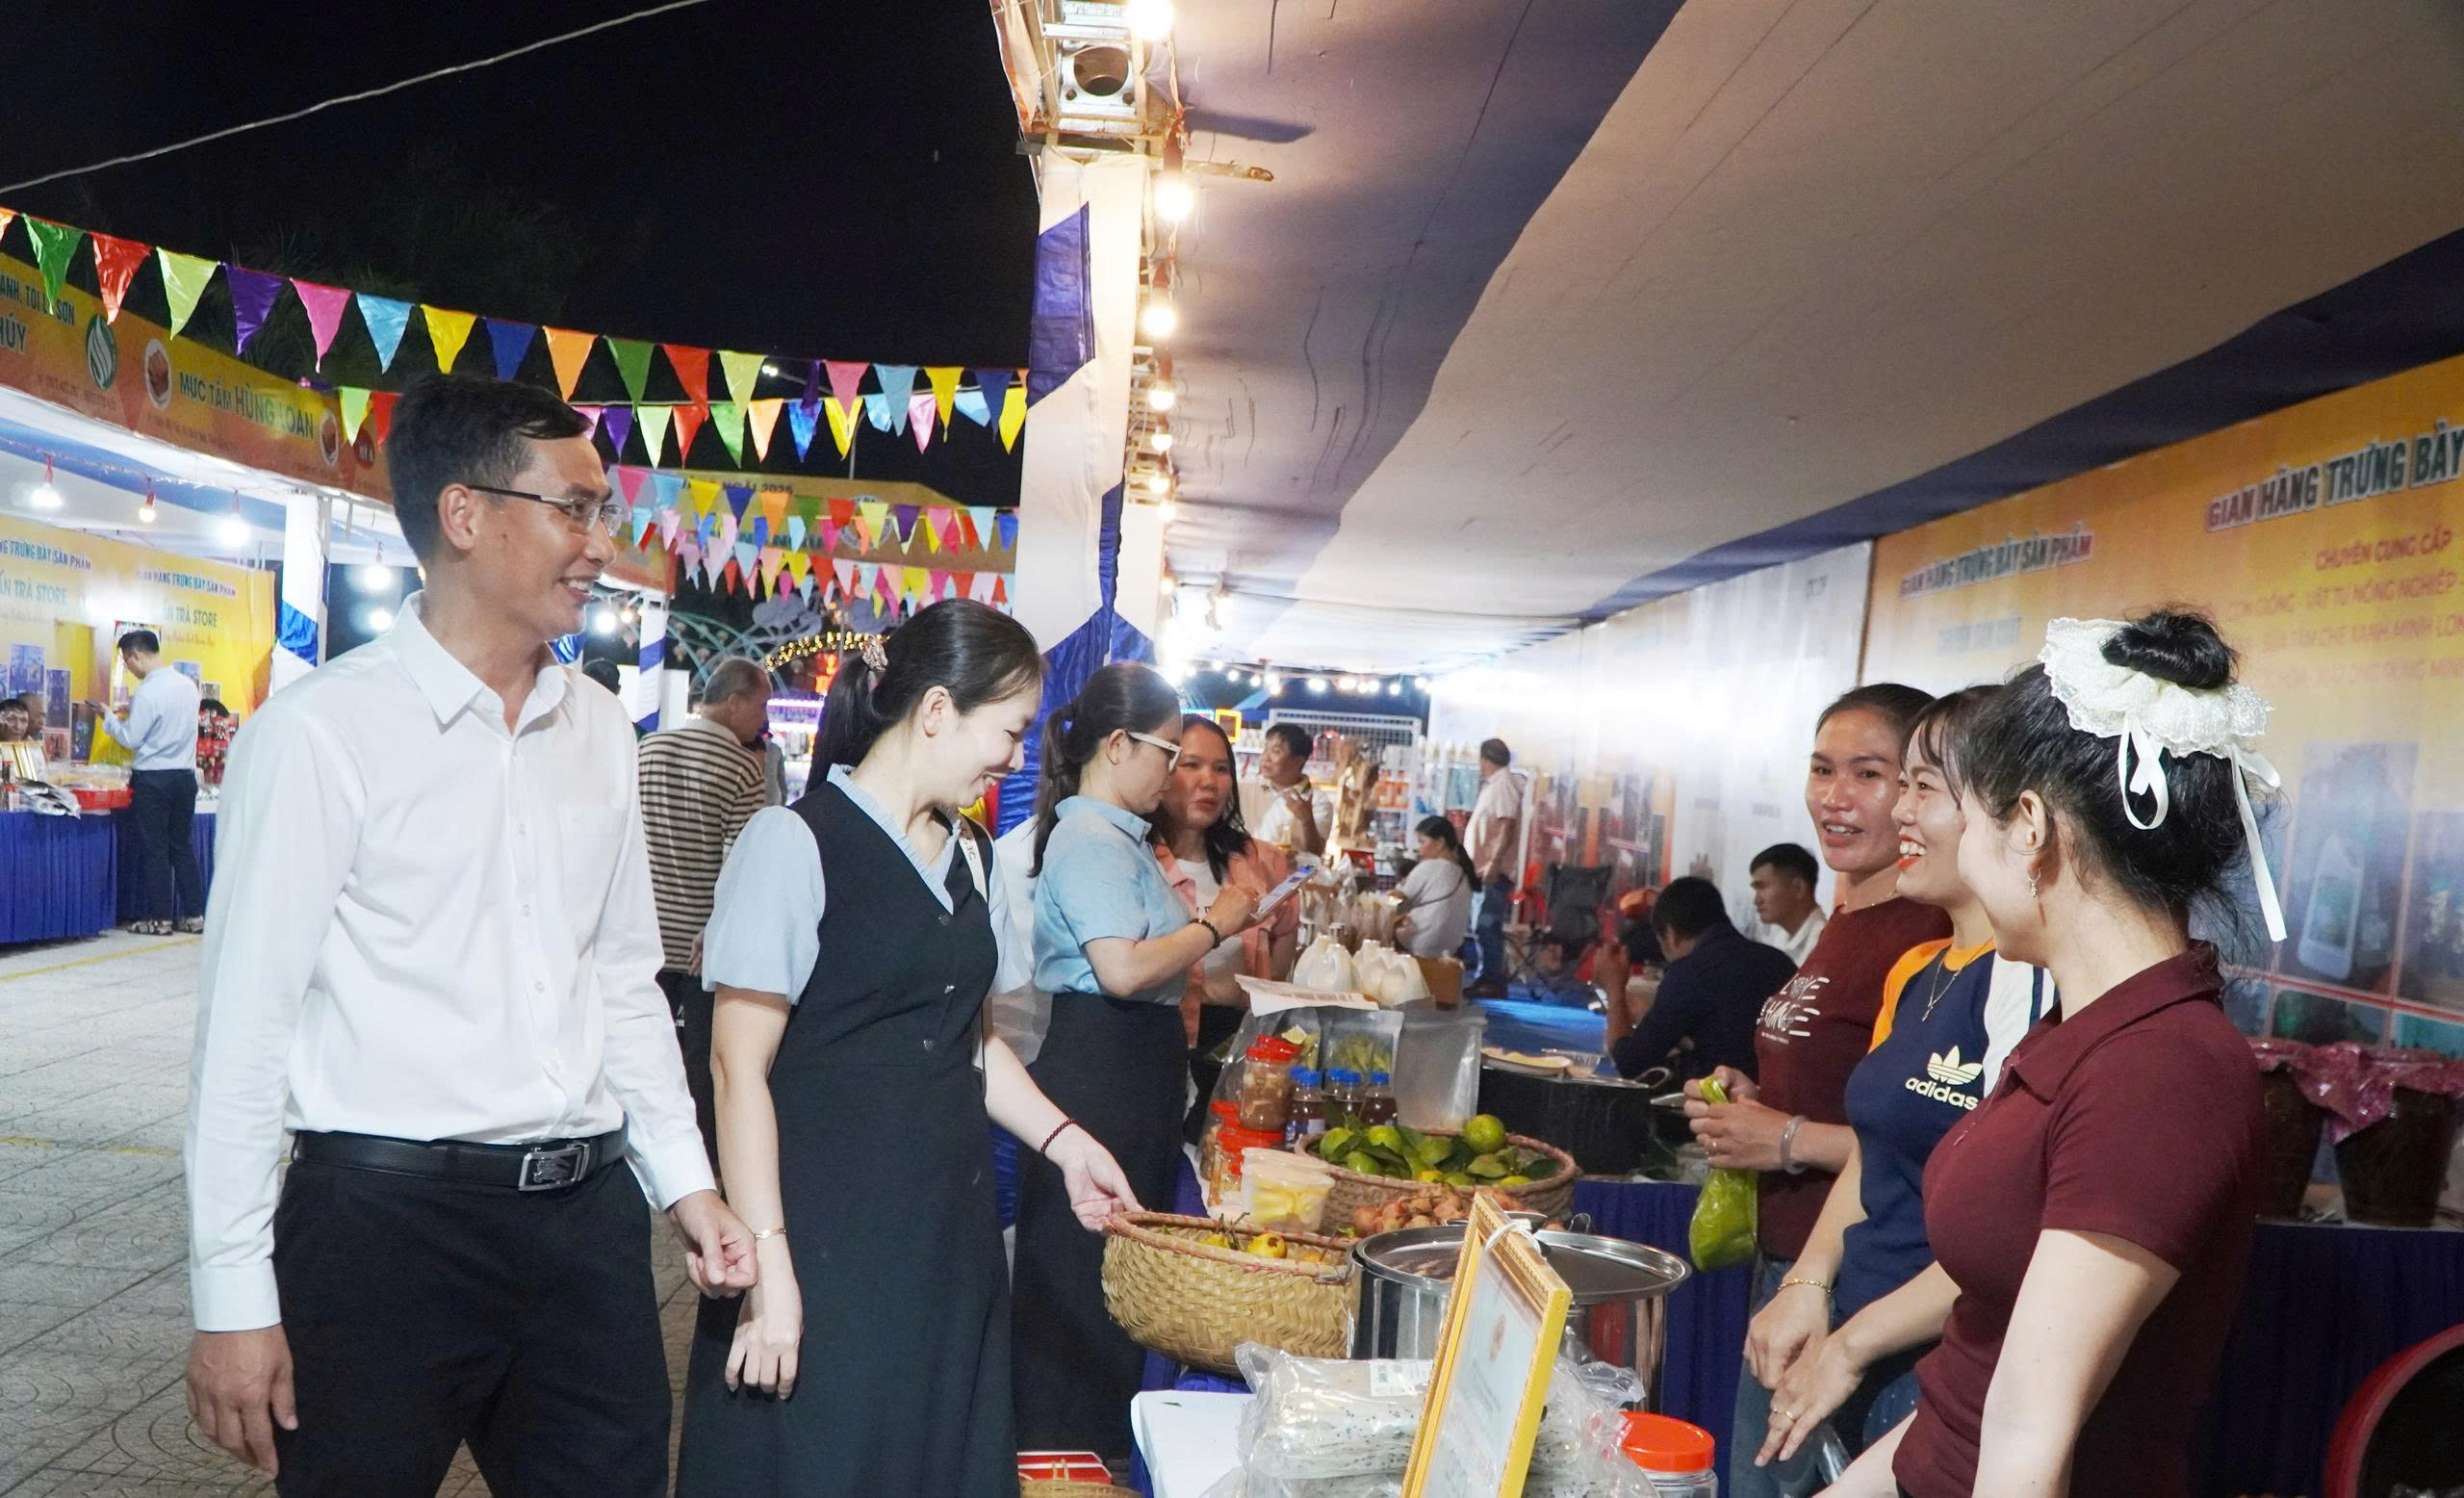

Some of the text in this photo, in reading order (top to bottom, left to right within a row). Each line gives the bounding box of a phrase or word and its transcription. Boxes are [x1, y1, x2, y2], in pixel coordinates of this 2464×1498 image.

[2207, 488, 2255, 529] GIAN
[2256, 466, 2320, 517] HÀNG
[1905, 1077, 1979, 1110] adidas
